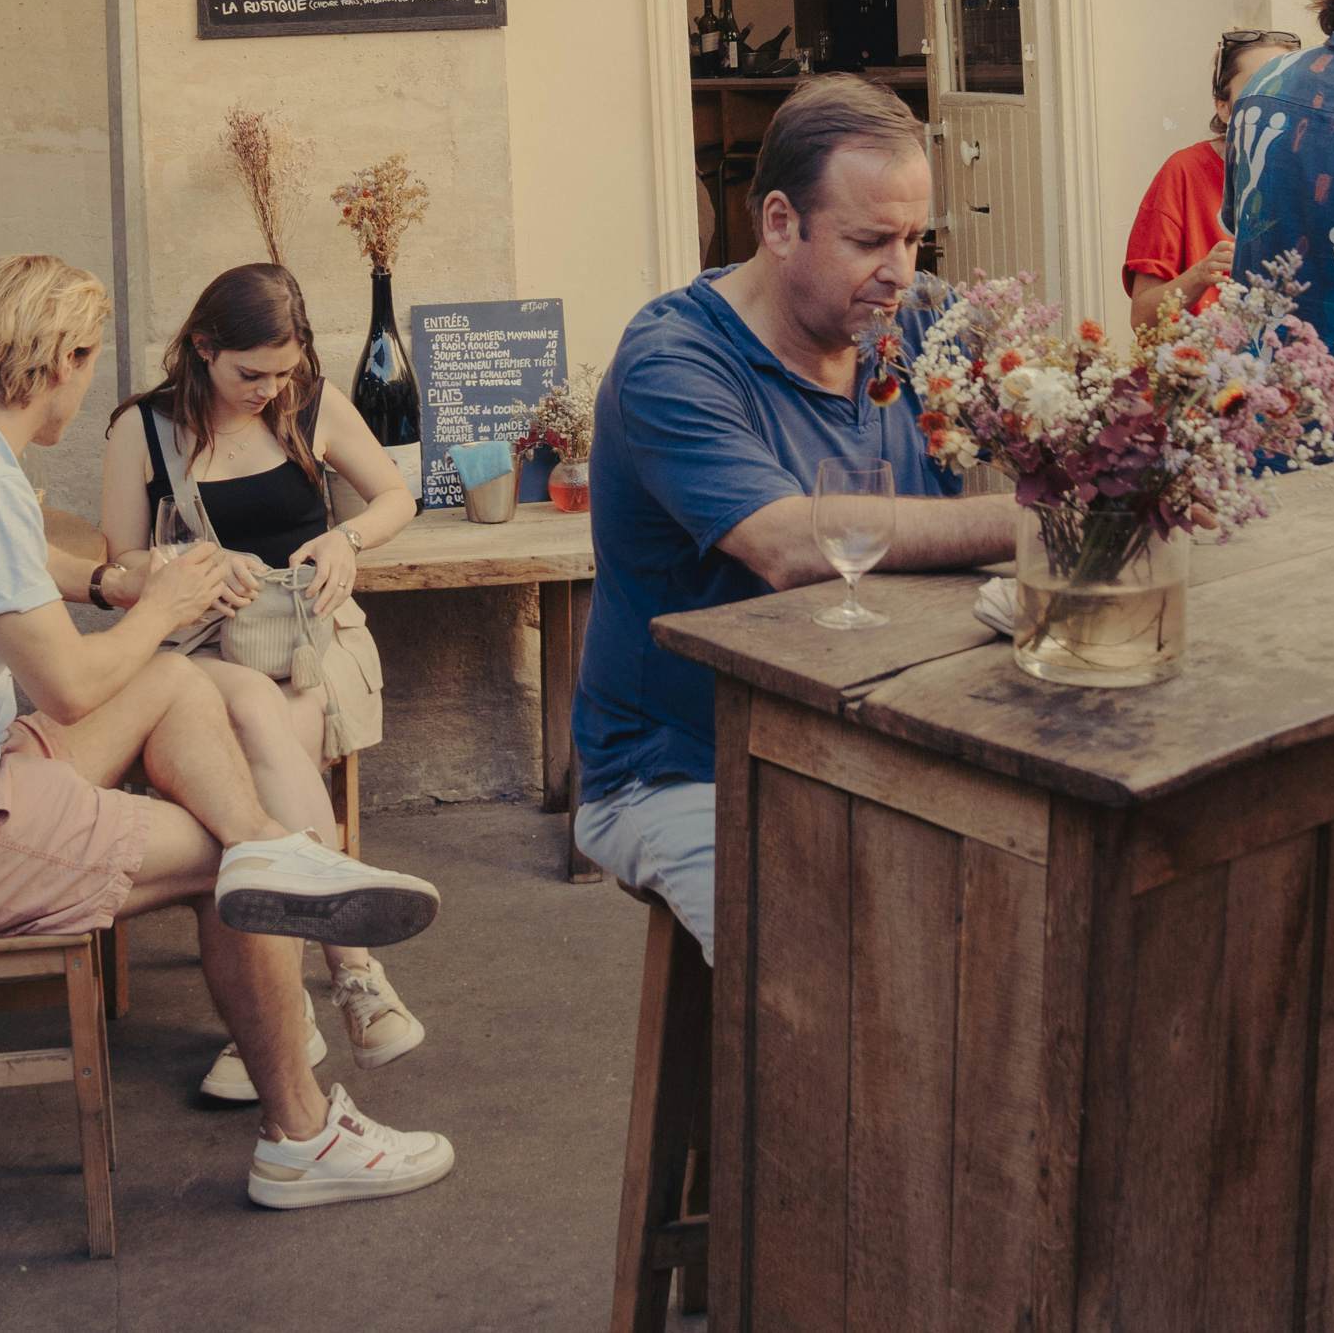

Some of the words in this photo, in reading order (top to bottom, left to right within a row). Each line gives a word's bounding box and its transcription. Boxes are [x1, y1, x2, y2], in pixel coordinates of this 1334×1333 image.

[222, 2, 238, 15] LA
[423, 312, 470, 329] ENTRÉES
[507, 327, 559, 341] MAYONNAISE
[441, 342, 467, 351] RADIS
[467, 342, 500, 351] ROUGES
[546, 340, 557, 349] 10
[433, 351, 461, 361] SOUPE
[433, 359, 492, 370] JAMBONNEAU
[494, 357, 532, 368] FERMIER
[542, 369, 554, 378] 11
[428, 388, 464, 403] PLATS
[438, 405, 481, 417] SAUCISSE
[436, 416, 469, 425] CANTAL
[436, 425, 473, 435] POULETTE
[494, 420, 531, 432] LANDES
[434, 433, 475, 443] TARTARE
[493, 432, 530, 441] COUTEAU
[429, 495, 443, 504] LA
